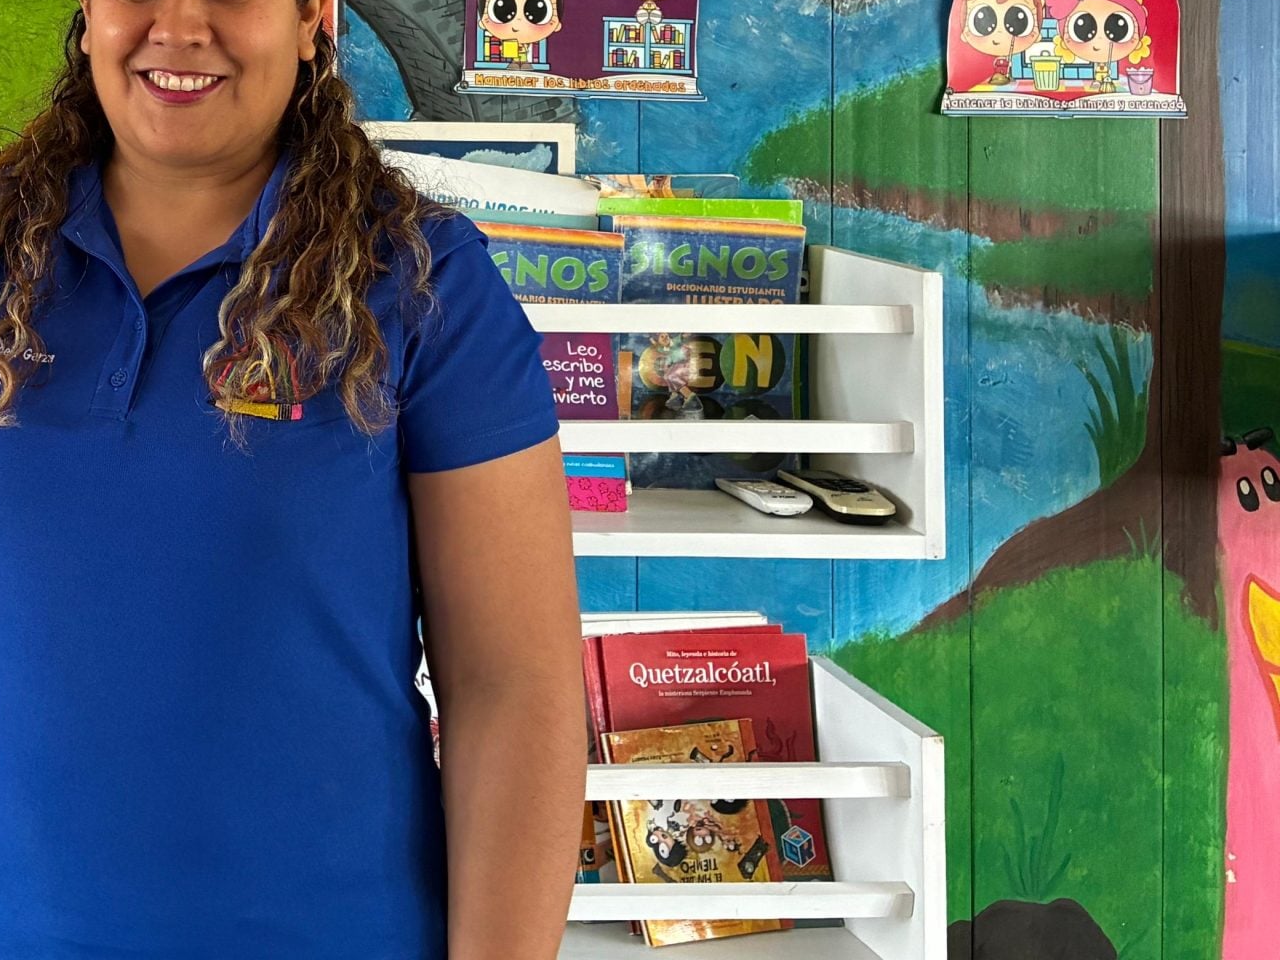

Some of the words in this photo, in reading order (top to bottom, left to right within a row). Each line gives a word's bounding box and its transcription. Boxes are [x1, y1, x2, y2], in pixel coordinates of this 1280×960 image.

[475, 73, 540, 88] Mantener
[543, 76, 565, 88] los
[569, 77, 611, 90] libros
[614, 78, 687, 93] ordenados
[943, 97, 997, 109] Mantener
[999, 98, 1013, 109] la
[1015, 97, 1077, 109] biblioteca
[1078, 97, 1116, 111] limpia
[1127, 98, 1185, 110] ordenada
[630, 240, 790, 282] SIGNOS
[666, 282, 726, 294] DICCIONARIO
[727, 286, 786, 297] ESTUDIANTIL
[566, 340, 603, 360] Leo,
[542, 358, 604, 374] escribo
[565, 376, 574, 392] y
[579, 376, 605, 388] me
[552, 388, 608, 406] ivierto
[629, 661, 777, 688] Quetzalcóatl,
